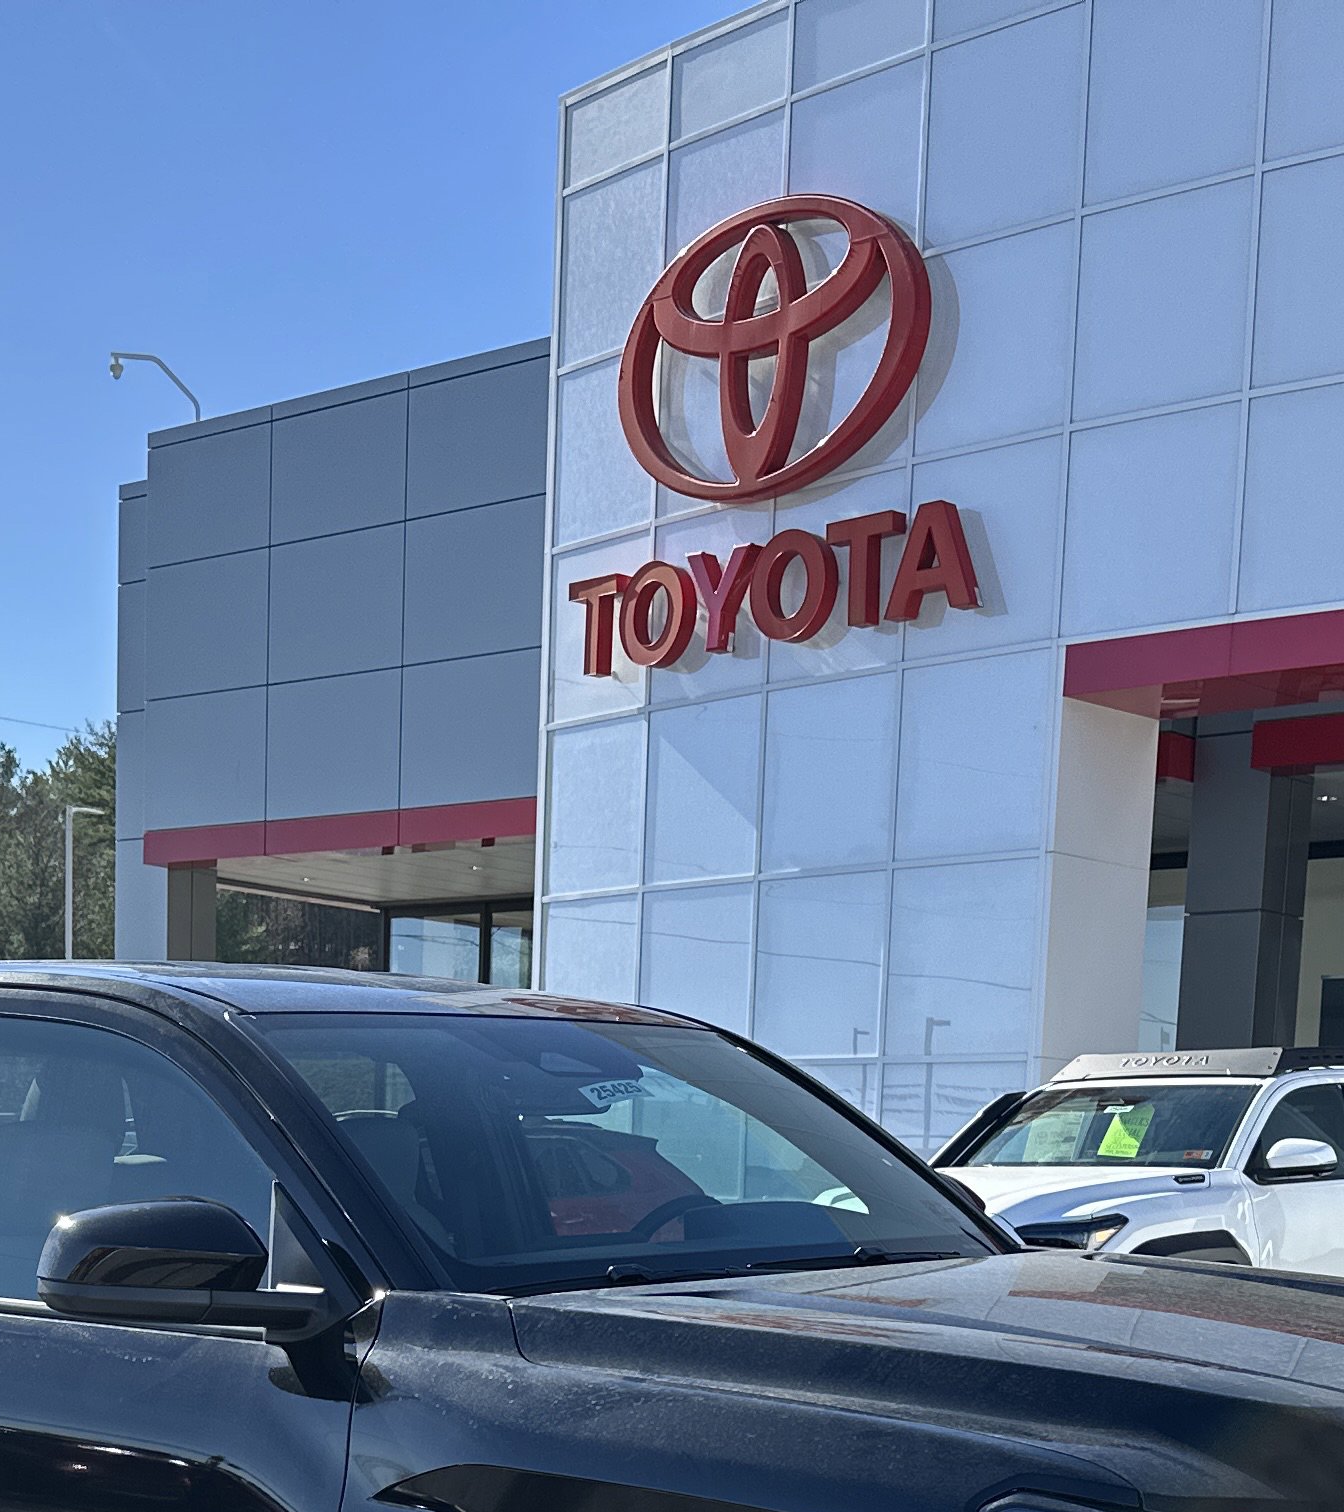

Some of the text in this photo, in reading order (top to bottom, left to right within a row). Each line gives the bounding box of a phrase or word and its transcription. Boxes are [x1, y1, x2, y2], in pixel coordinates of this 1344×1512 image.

[568, 500, 984, 677] TOYOTA
[1120, 1055, 1209, 1068] TOYOTA
[590, 1081, 643, 1101] 25425
